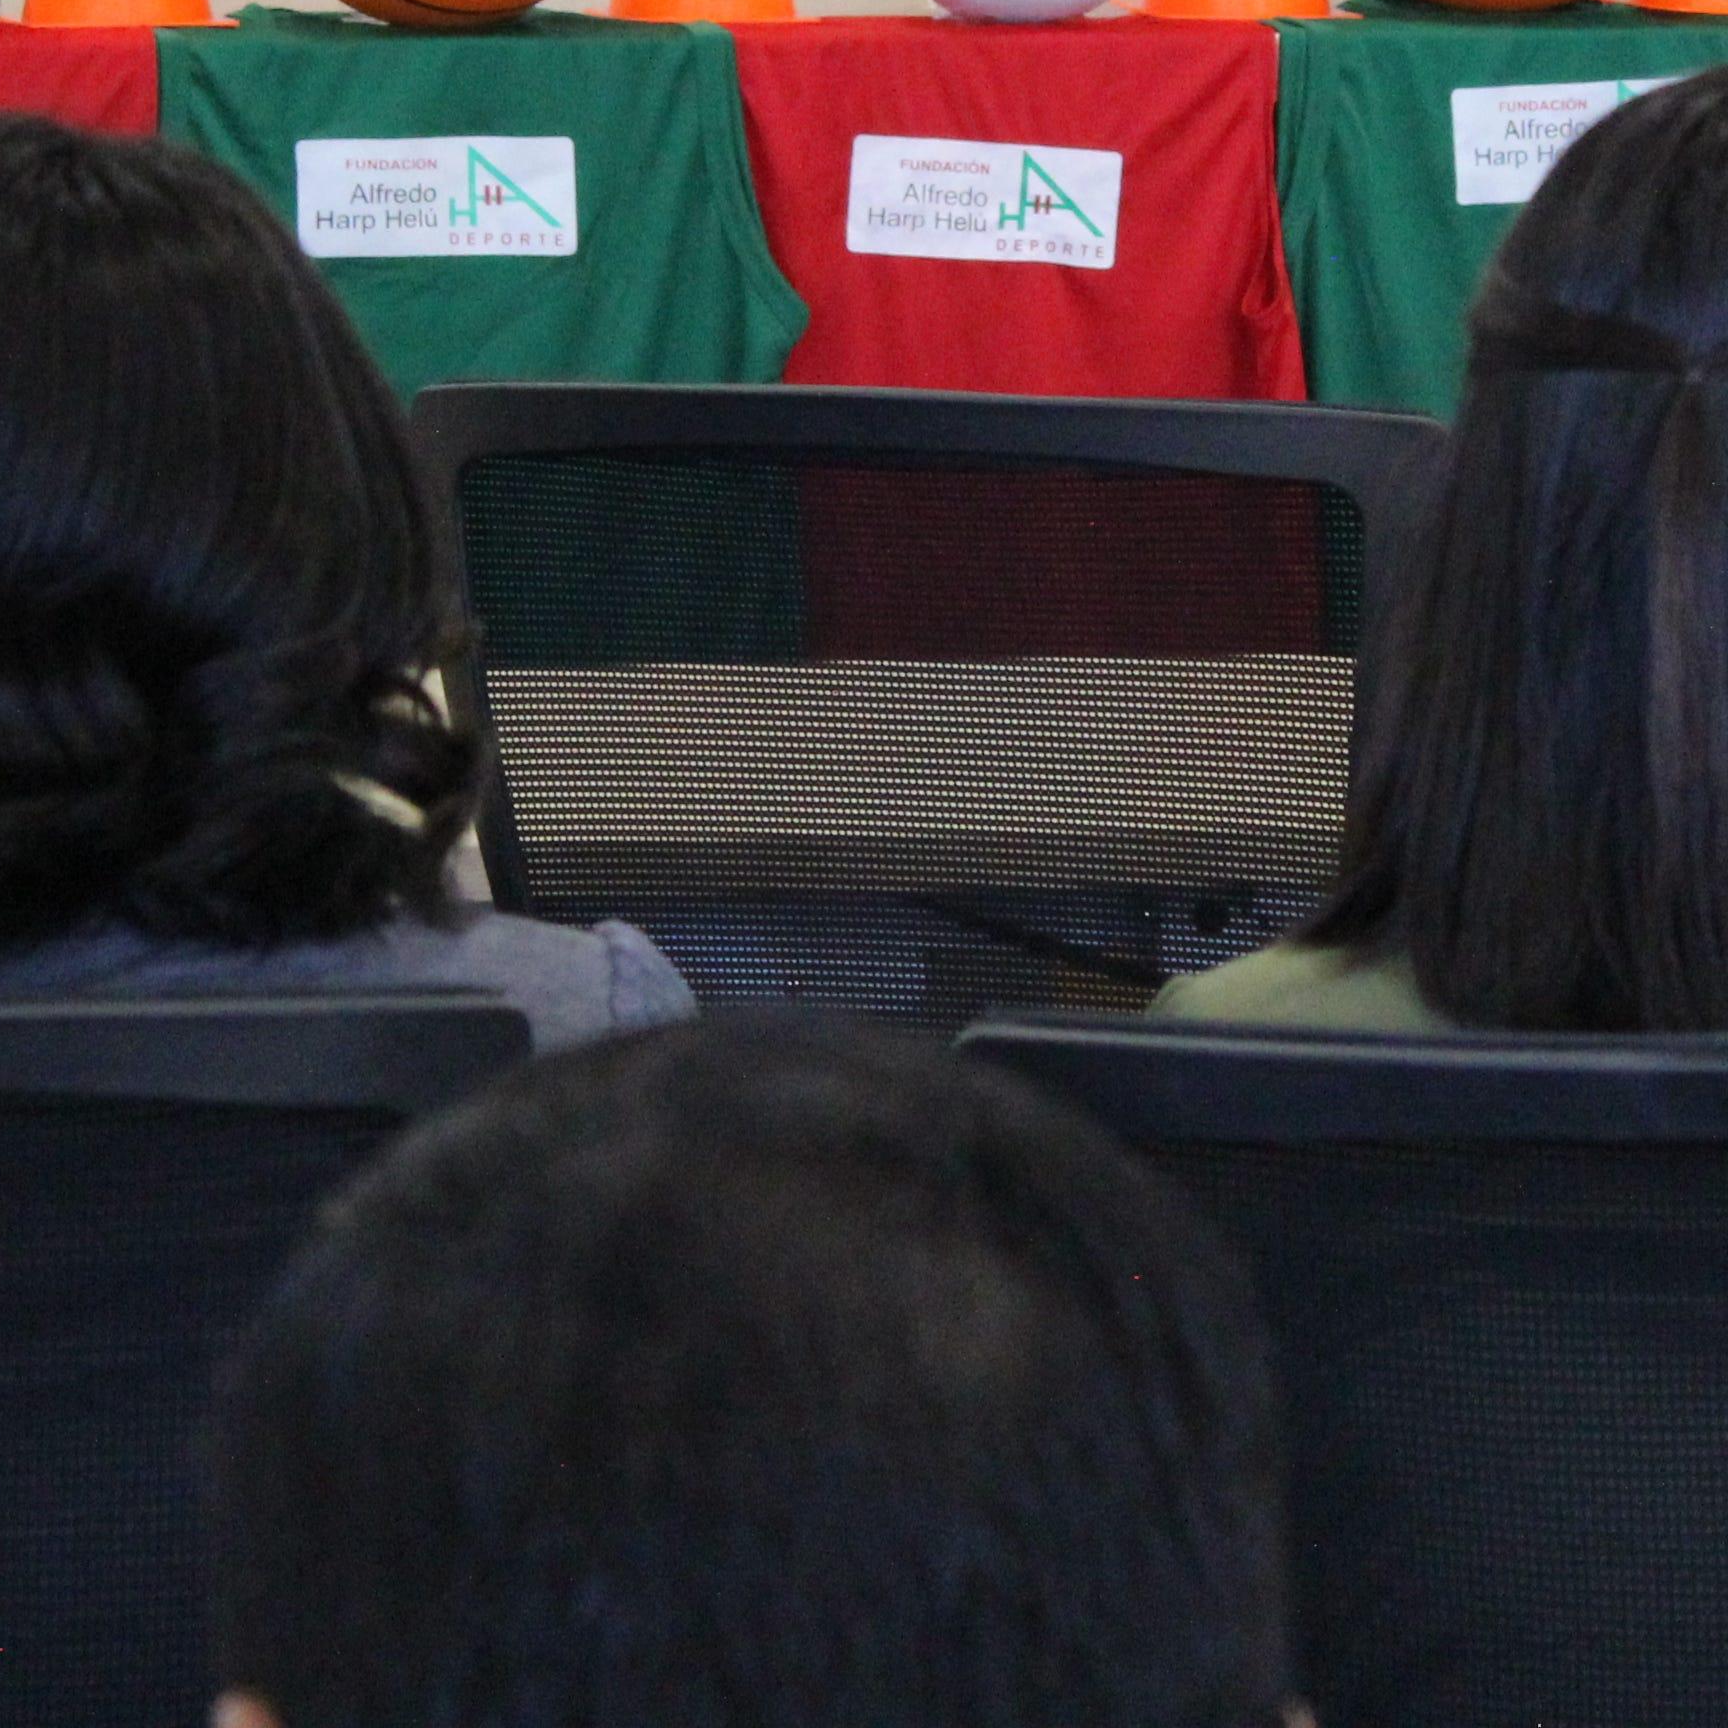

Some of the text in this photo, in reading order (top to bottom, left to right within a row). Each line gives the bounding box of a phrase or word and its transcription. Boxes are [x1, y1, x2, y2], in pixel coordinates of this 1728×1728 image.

[1475, 147, 1527, 169] Harp
[350, 183, 437, 204] Alfredo
[903, 183, 988, 207] Alfredo
[316, 209, 437, 234] Harp Helú
[868, 208, 987, 232] Harp Helú
[450, 232, 564, 246] DEPORTE
[997, 238, 1104, 258] DEPORTE
